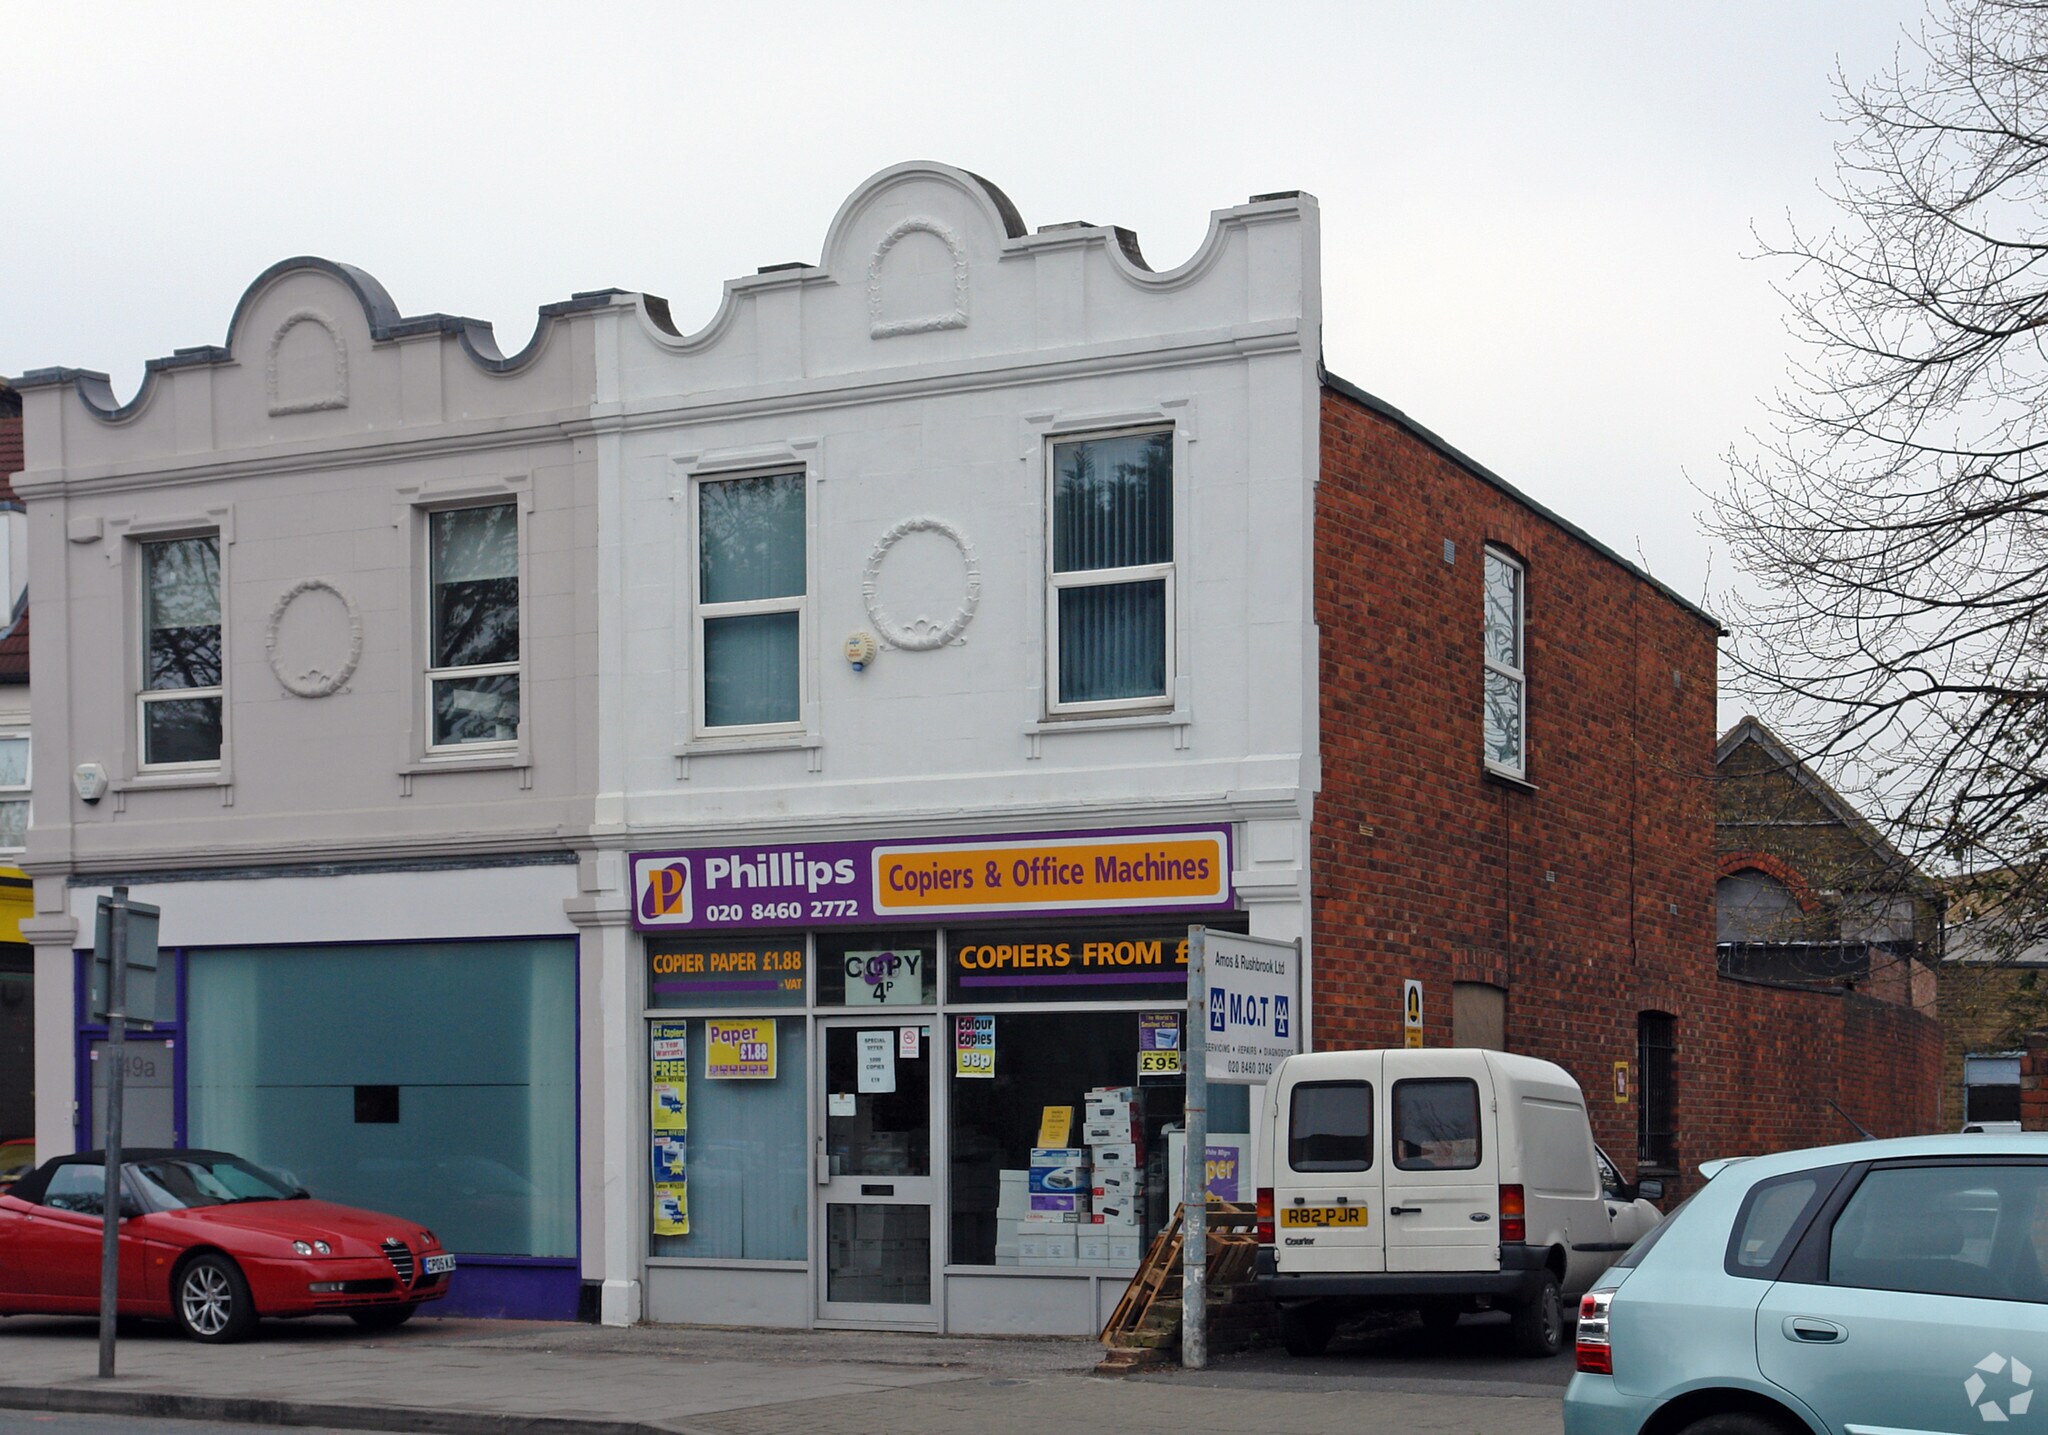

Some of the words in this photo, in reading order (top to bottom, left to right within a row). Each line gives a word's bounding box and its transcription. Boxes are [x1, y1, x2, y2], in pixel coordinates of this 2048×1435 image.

[705, 852, 856, 893] Phillips
[889, 862, 974, 897] Copiers
[984, 861, 1001, 888] &
[1012, 857, 1084, 887] Office
[1095, 852, 1209, 884] Machines
[706, 904, 743, 921] 020
[751, 902, 801, 920] 8460
[810, 900, 858, 917] 2772
[653, 953, 704, 974] COPIER
[710, 952, 756, 972] PAPER
[763, 951, 802, 970] £1.88
[959, 943, 1070, 969] COPIERS
[1083, 941, 1162, 966] FROM
[1215, 951, 1234, 968] Amos
[1235, 954, 1240, 969] &
[1241, 955, 1274, 973] Rushbrook
[1275, 960, 1285, 975] Ltd
[845, 955, 920, 978] COPY
[1230, 993, 1269, 1027] M.O.T
[959, 1018, 993, 1030] Colour
[710, 1026, 758, 1047] Paper
[959, 1031, 992, 1047] Copies
[656, 1049, 683, 1057] Warranty
[740, 1043, 768, 1061] £1.88
[1205, 1042, 1231, 1053] SERVICING
[1237, 1044, 1257, 1055] REPAIRS
[1264, 1047, 1294, 1057] DIAGNOSTICS
[653, 1061, 686, 1076] FREE
[962, 1052, 992, 1070] 98p
[1142, 1057, 1178, 1070] £95
[1228, 1060, 1239, 1073] 020
[1241, 1061, 1257, 1074] 8460
[1258, 1062, 1272, 1075] 3745
[1289, 1209, 1321, 1223] R82
[1325, 1208, 1359, 1223] PJR
[1285, 1237, 1315, 1246] Courier
